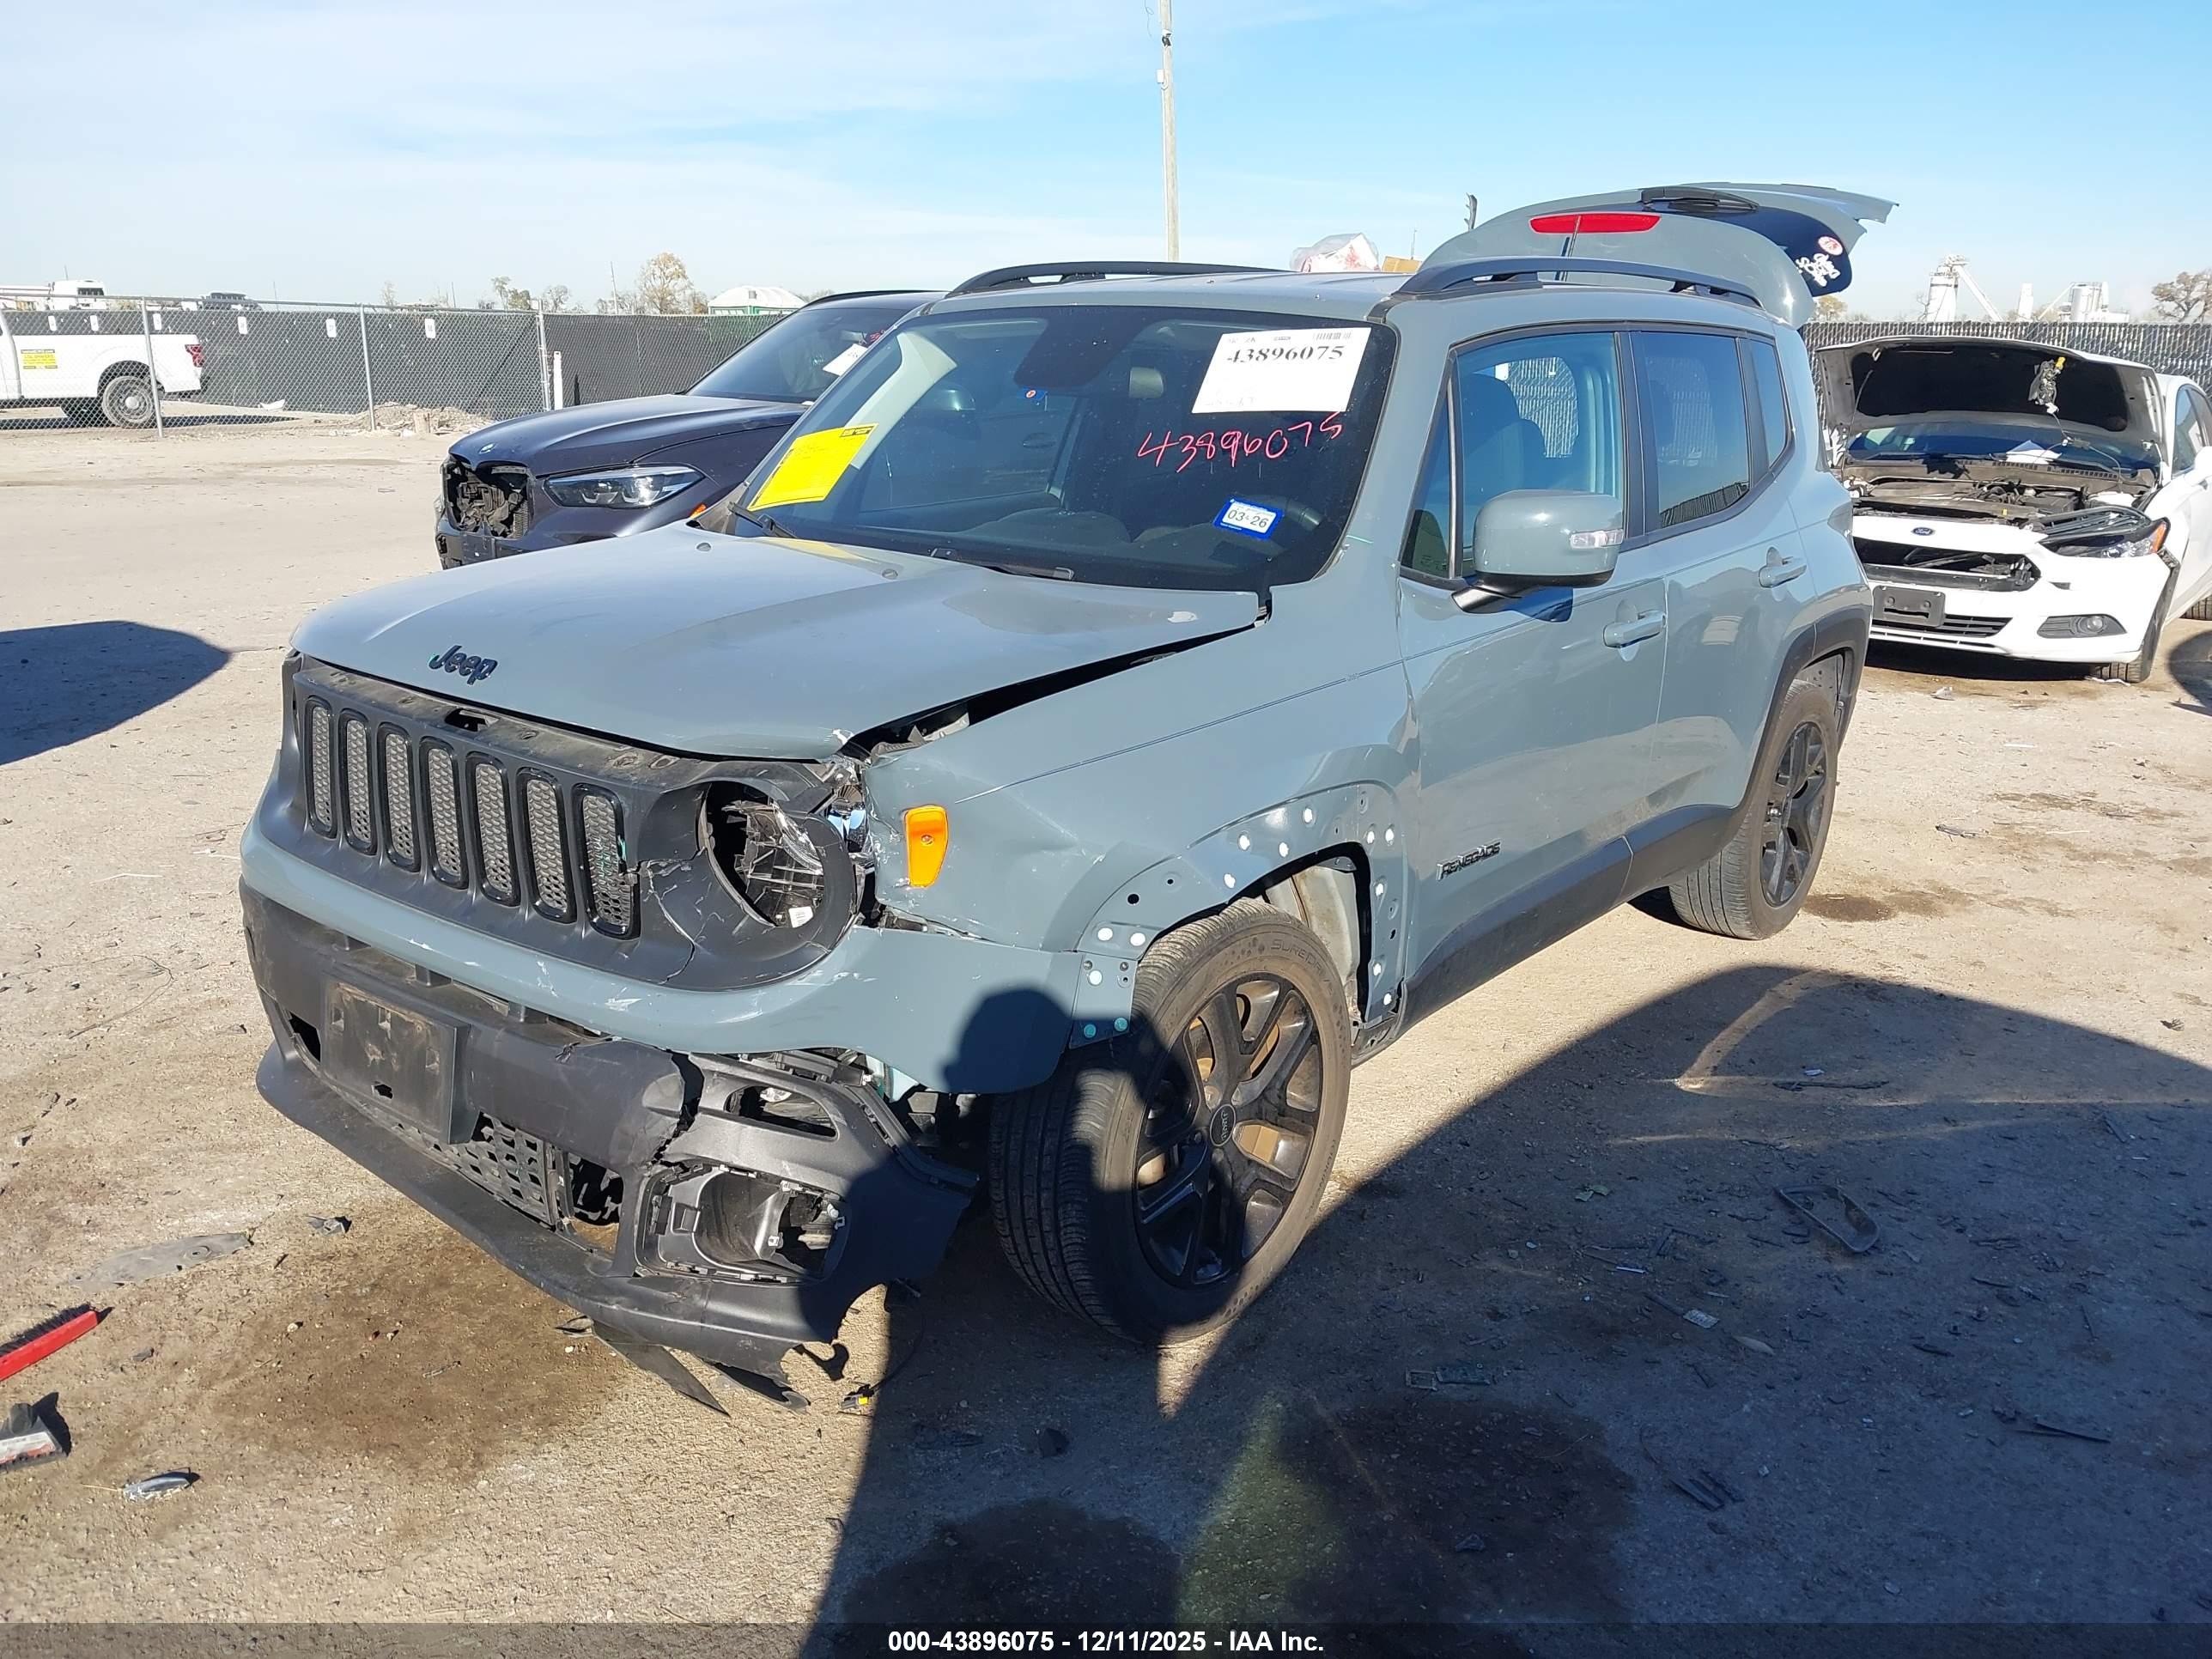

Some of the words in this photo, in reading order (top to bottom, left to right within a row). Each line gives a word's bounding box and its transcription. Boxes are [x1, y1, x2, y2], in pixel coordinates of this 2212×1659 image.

[1226, 345, 1346, 363] 43896075
[1137, 411, 1343, 473] 43896075
[428, 645, 498, 685] Jeep
